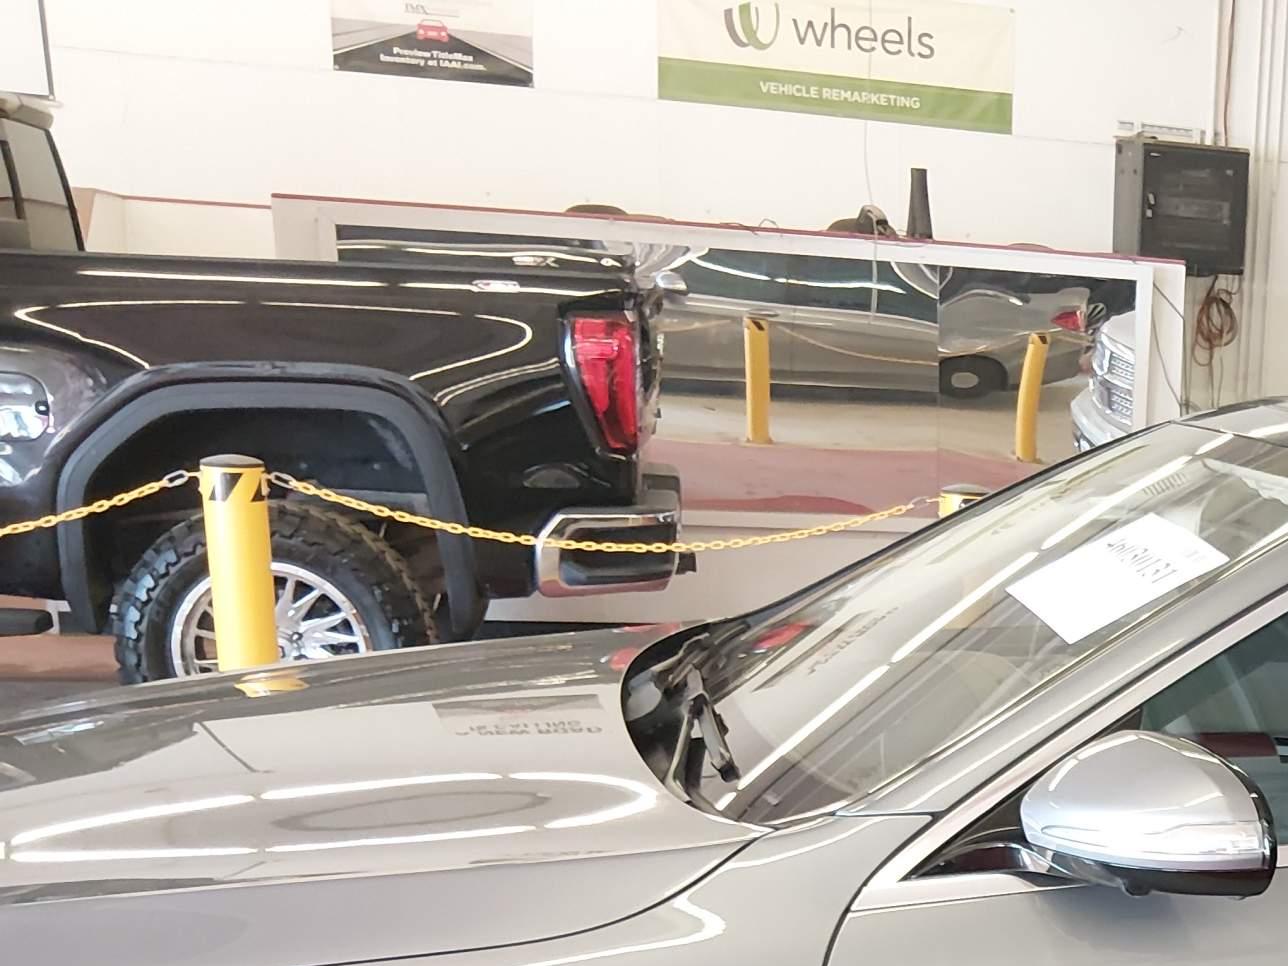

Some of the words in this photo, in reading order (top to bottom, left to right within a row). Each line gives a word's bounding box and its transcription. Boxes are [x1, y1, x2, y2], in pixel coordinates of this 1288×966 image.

[792, 7, 936, 59] wheels
[759, 81, 820, 99] VEHICLE
[823, 87, 921, 109] REMARKETING
